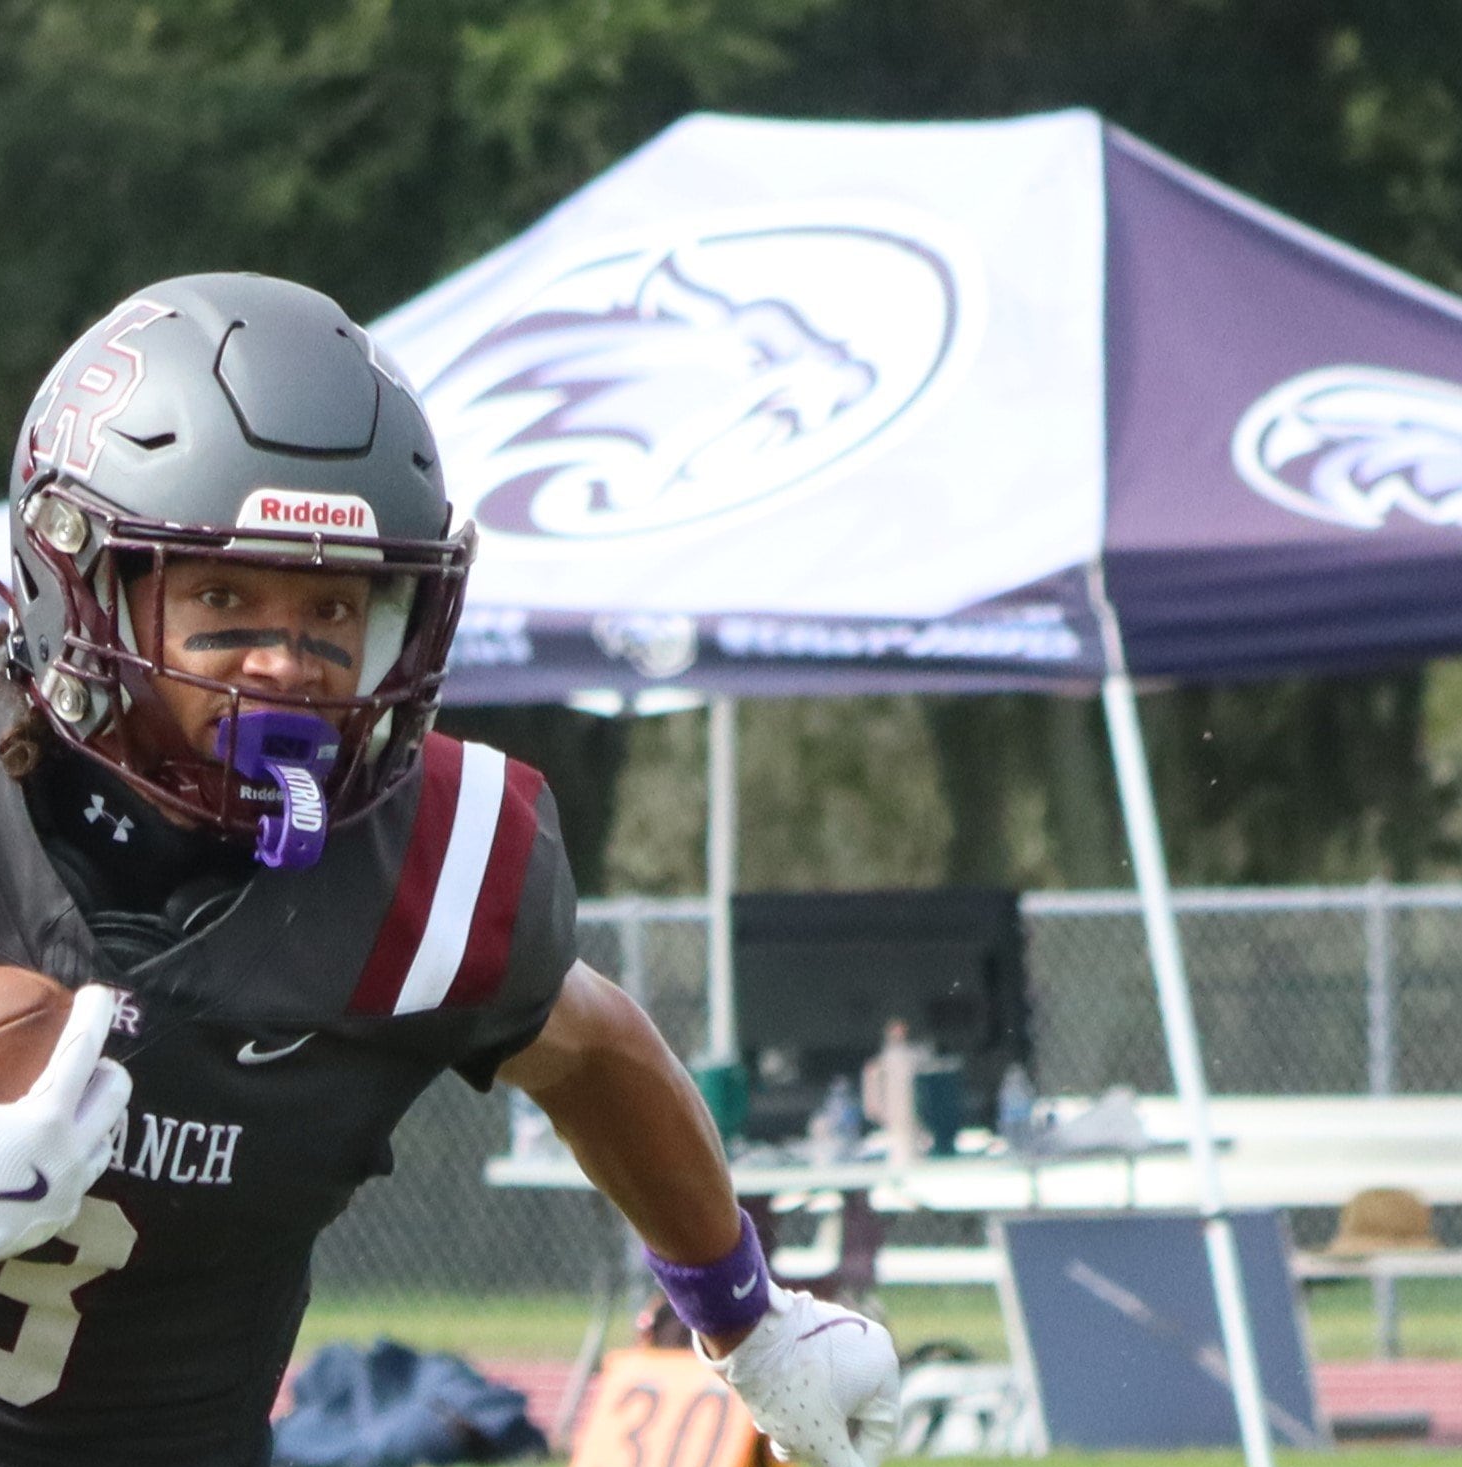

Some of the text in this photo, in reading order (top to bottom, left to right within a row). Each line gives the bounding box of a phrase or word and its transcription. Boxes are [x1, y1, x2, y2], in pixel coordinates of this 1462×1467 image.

[260, 498, 365, 528] Riddell
[239, 784, 285, 802] Ridde
[108, 1108, 244, 1185] ANCH
